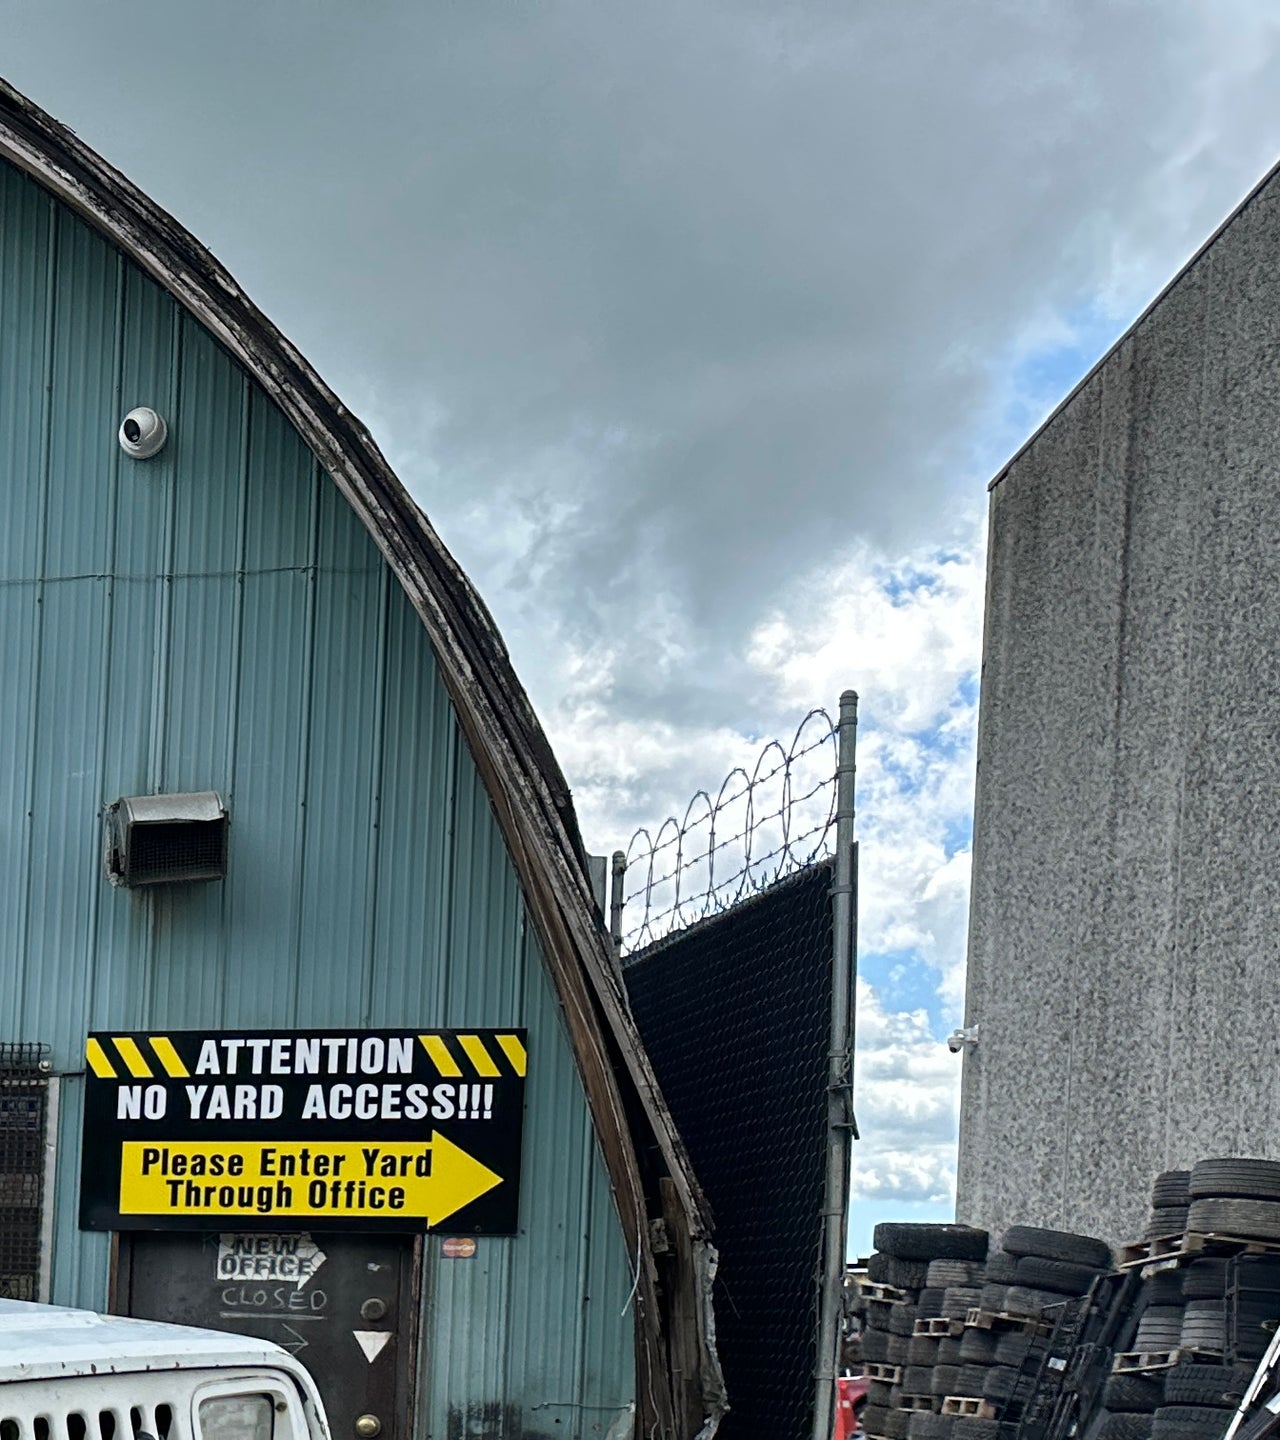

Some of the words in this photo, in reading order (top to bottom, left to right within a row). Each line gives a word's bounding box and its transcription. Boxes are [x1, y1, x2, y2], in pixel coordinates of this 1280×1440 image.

[195, 1038, 414, 1075] ATTENTION
[116, 1085, 167, 1120] NO
[186, 1085, 284, 1120] YARD
[301, 1083, 493, 1120] ACCESS!!!
[141, 1148, 243, 1177] Please
[259, 1148, 346, 1177] Enter
[362, 1148, 433, 1178] Yard
[166, 1180, 292, 1213] Through
[308, 1180, 406, 1210] Office
[234, 1236, 300, 1255] NEW
[220, 1254, 313, 1276] OFFICE
[221, 1287, 327, 1310] CLOSED
